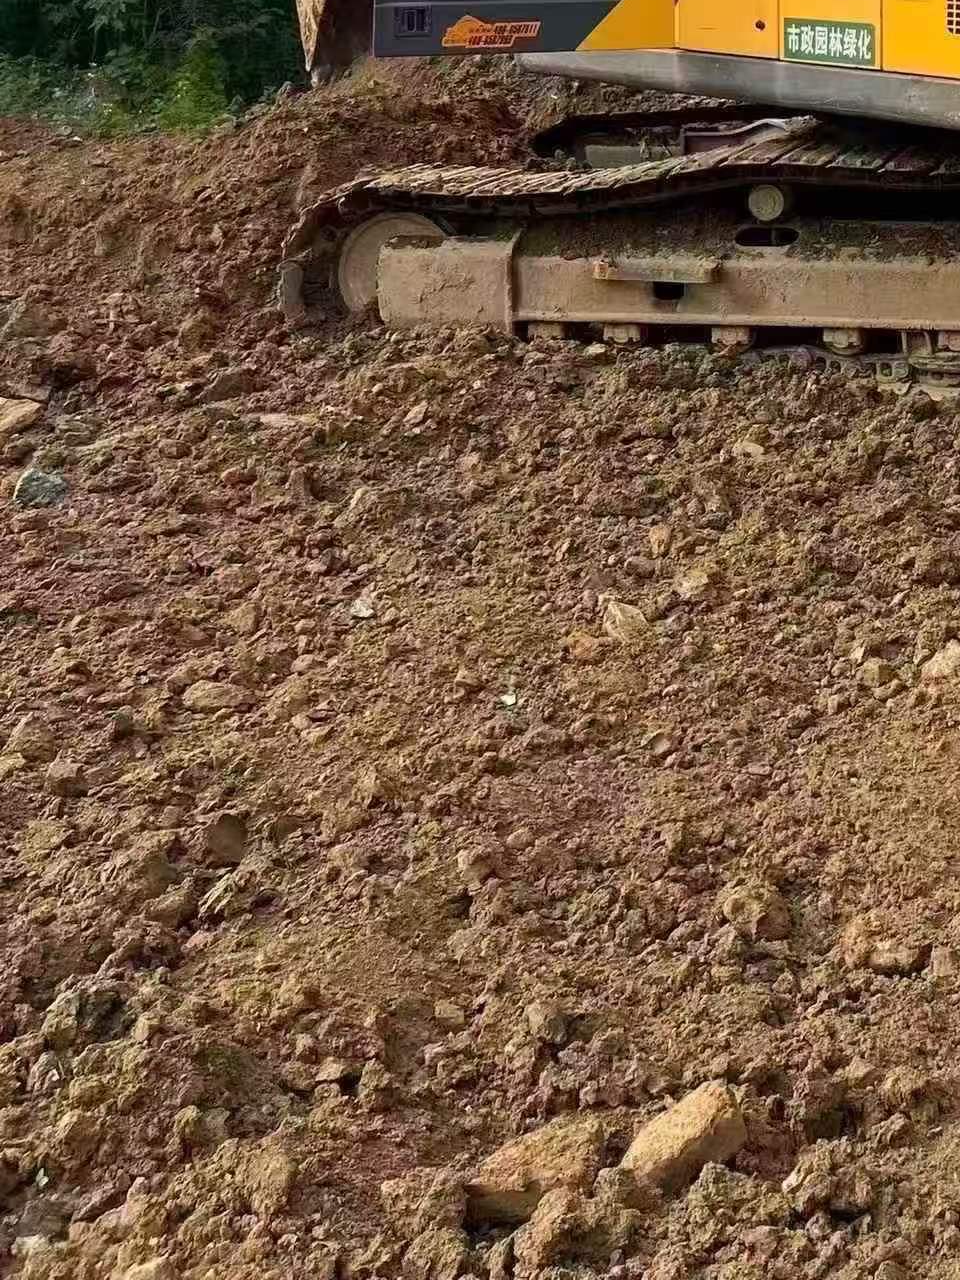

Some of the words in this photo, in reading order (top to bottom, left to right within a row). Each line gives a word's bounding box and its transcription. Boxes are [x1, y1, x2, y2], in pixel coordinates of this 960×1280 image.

[786, 23, 872, 60] 市政园林绿化
